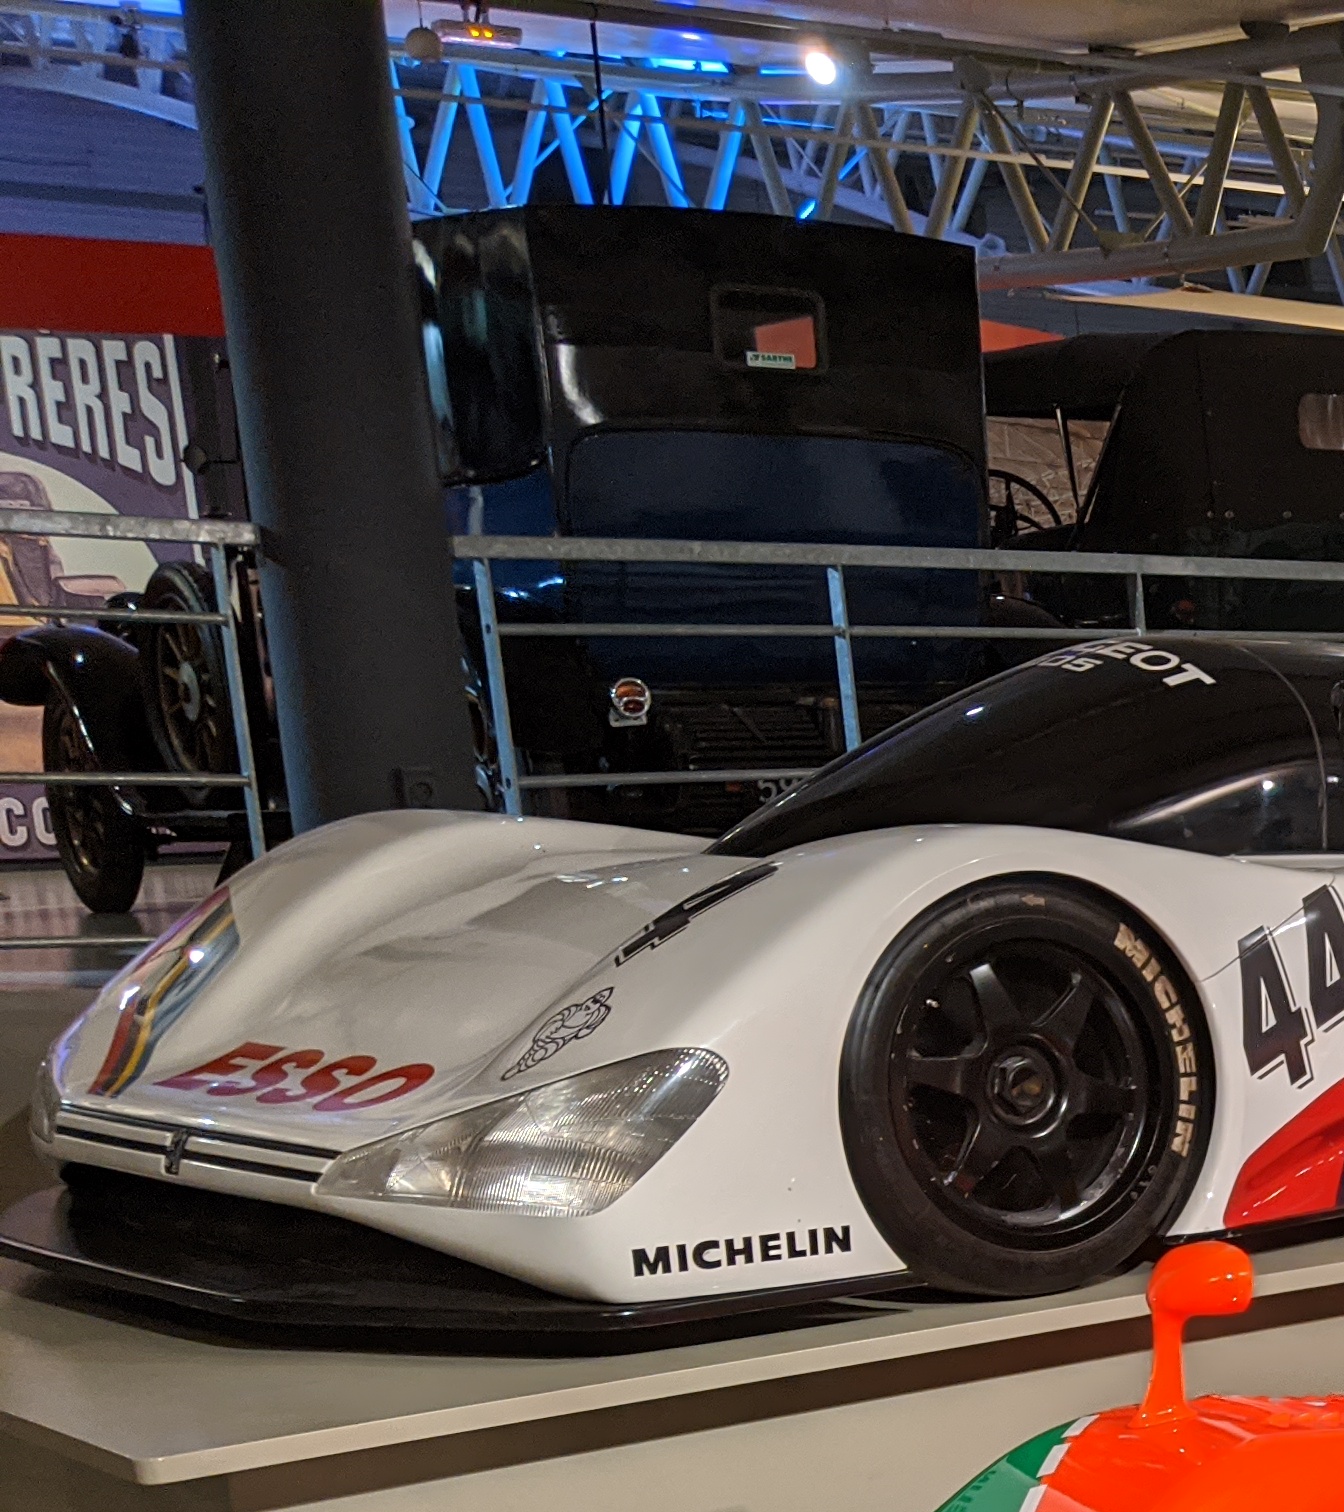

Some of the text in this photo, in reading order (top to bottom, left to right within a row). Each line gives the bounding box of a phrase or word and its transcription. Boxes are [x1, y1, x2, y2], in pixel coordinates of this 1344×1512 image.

[1113, 922, 1197, 1158] MICHELIN
[156, 1042, 435, 1113] ESSO
[631, 1225, 852, 1277] MICHELIN
